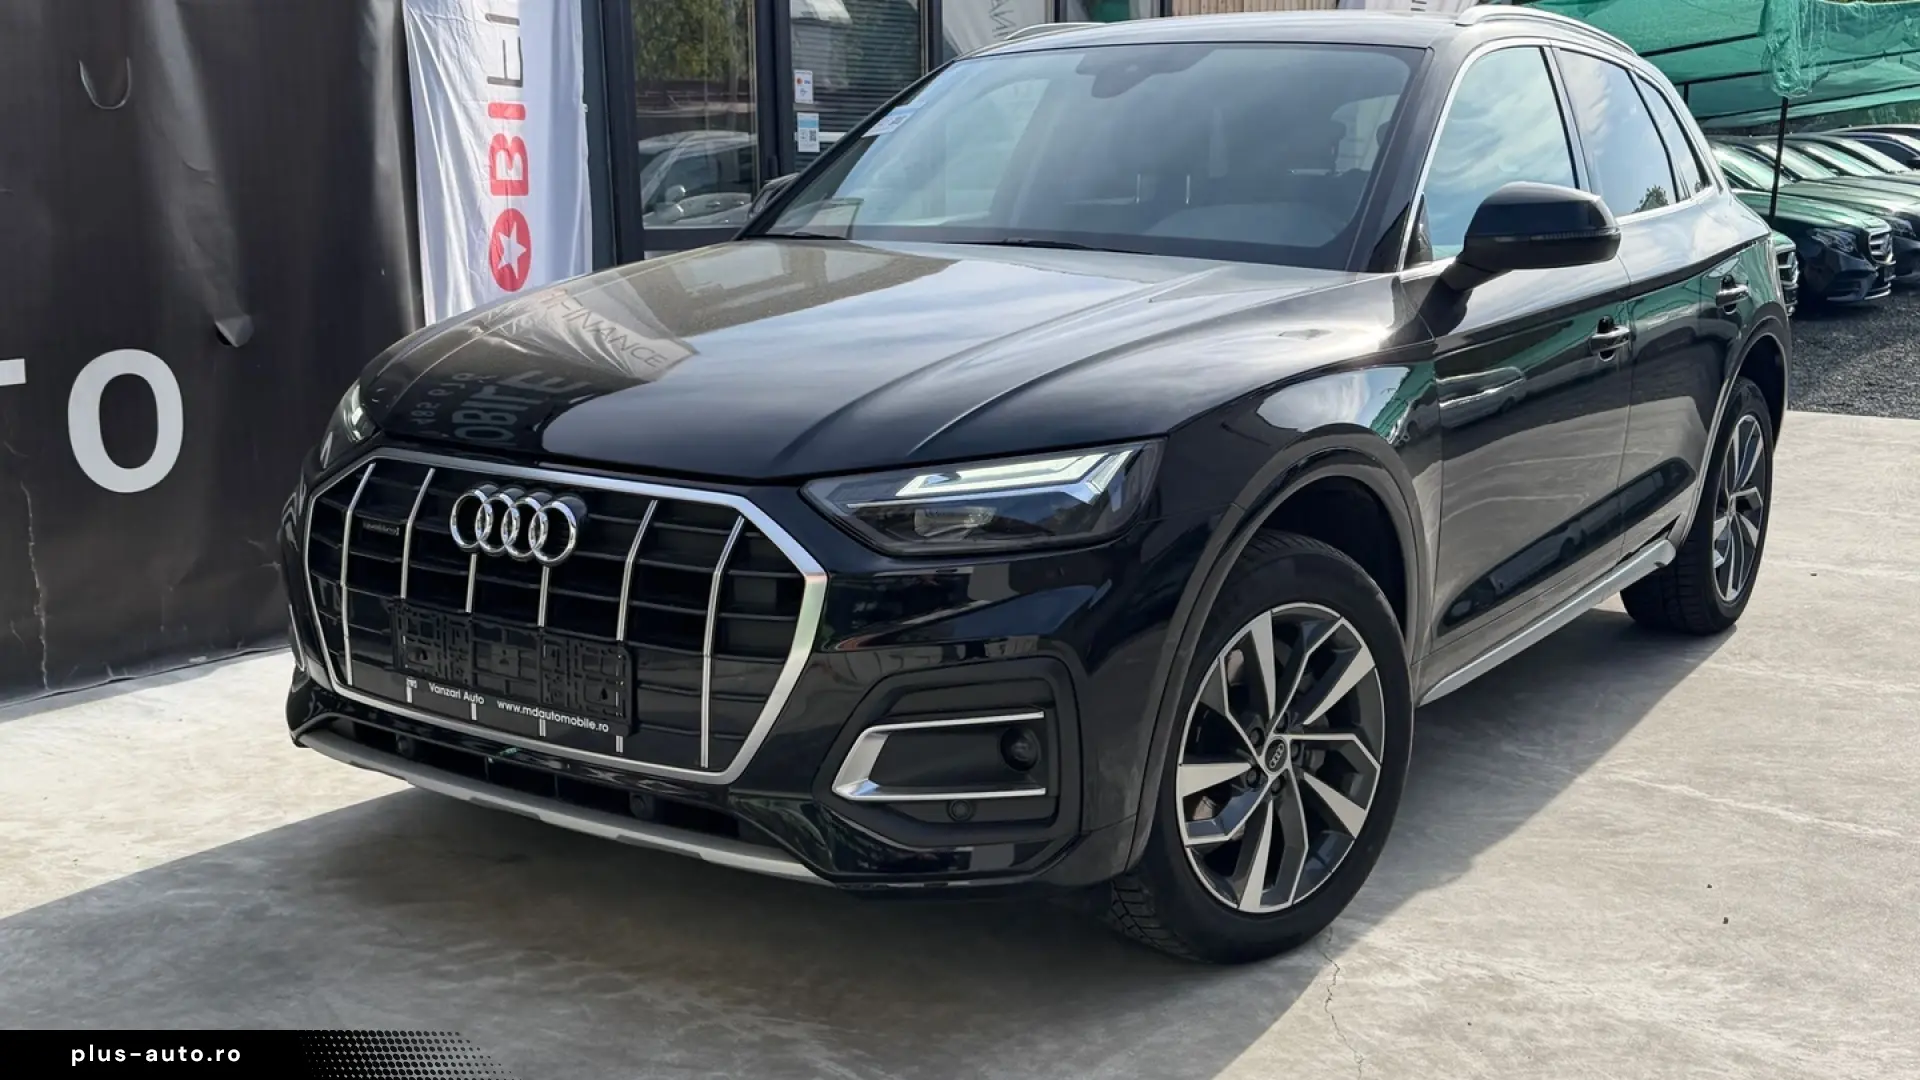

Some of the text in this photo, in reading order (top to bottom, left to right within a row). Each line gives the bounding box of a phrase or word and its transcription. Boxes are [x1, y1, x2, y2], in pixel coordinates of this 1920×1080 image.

[0, 348, 184, 493] O
[463, 689, 485, 705] Auto
[497, 699, 609, 733] www.mdautomobile.ro
